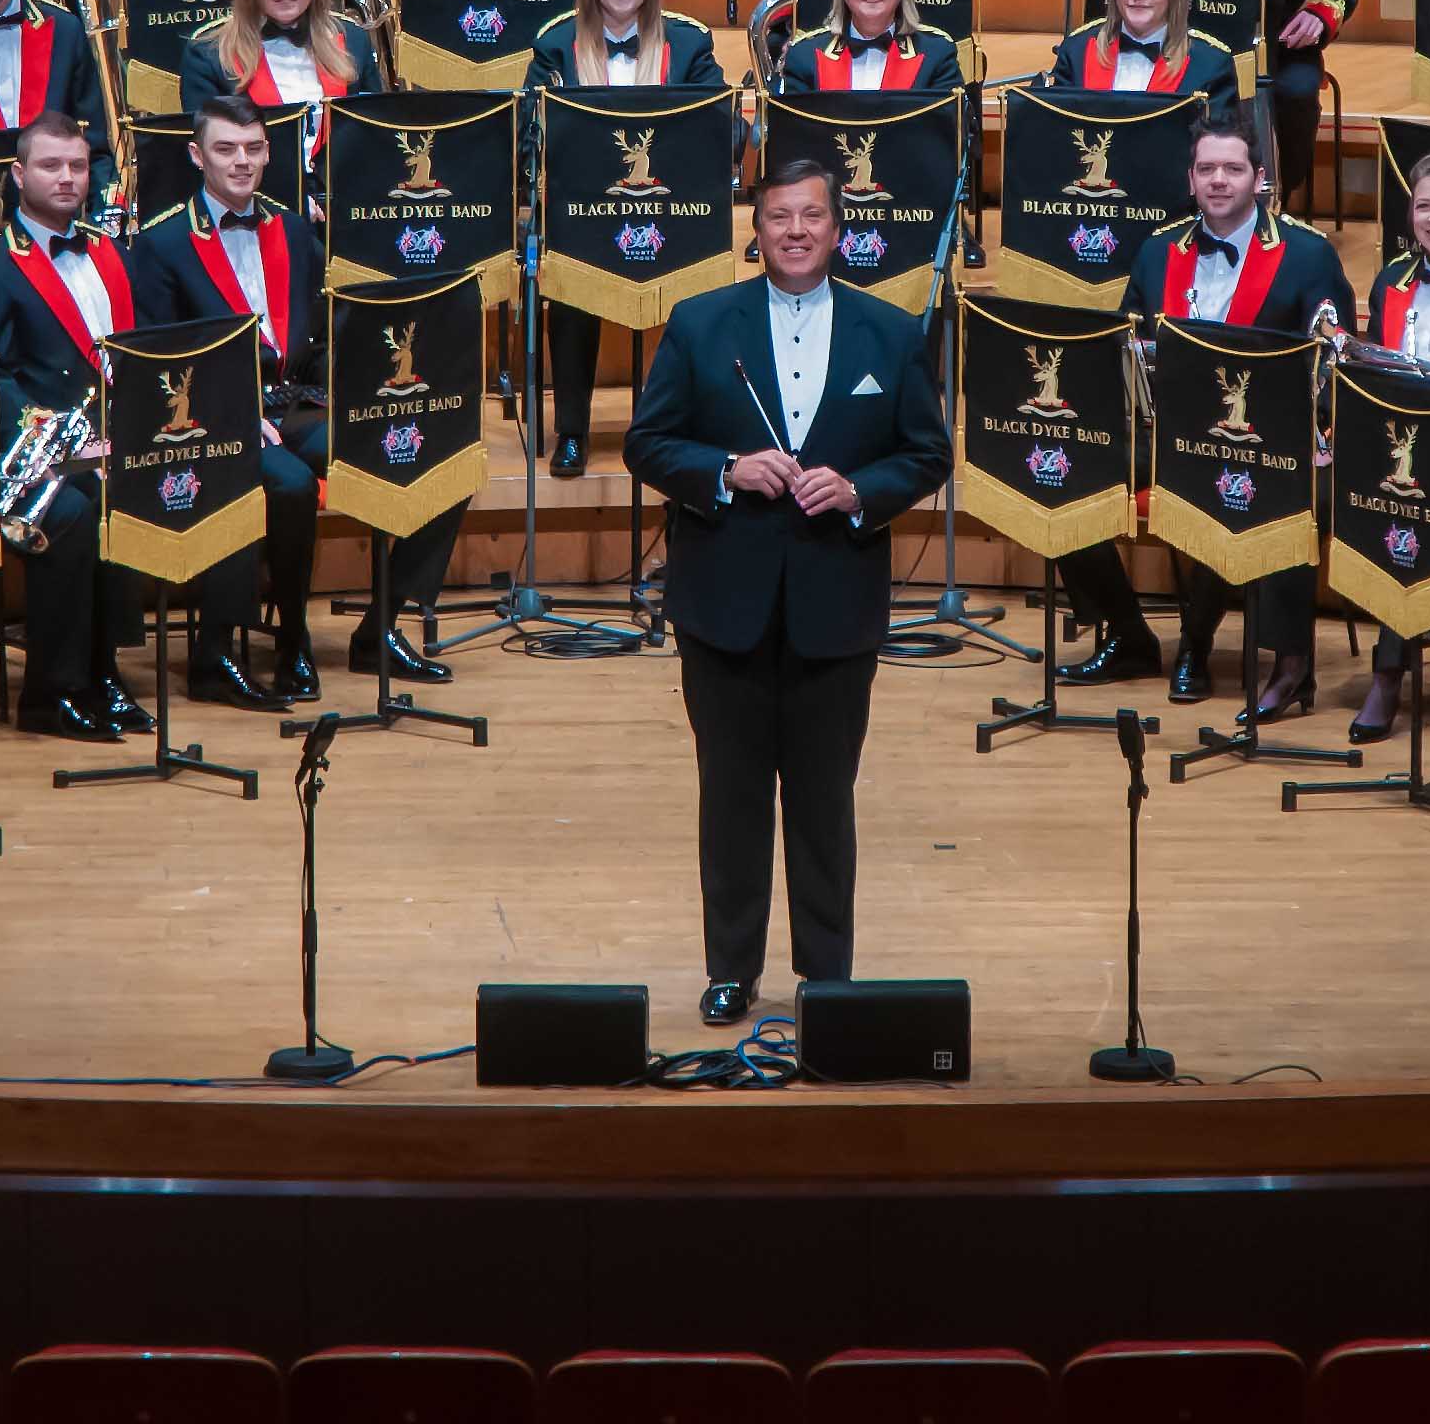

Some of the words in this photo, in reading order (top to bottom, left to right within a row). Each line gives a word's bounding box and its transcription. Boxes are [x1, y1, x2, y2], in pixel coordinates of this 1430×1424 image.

[148, 10, 192, 25] BLACK
[1199, 0, 1236, 15] BAND
[351, 206, 397, 219] BLACK
[403, 205, 444, 218] DYKE
[451, 205, 491, 217] BAND
[568, 203, 617, 216] BLACK
[621, 203, 662, 214] DYKE
[671, 203, 710, 215] BAND
[844, 208, 885, 220] DYKE
[893, 209, 933, 221] BAND
[1023, 200, 1072, 215] BLACK
[1076, 203, 1118, 217] DYKE
[1126, 207, 1166, 220] BAND
[349, 405, 383, 422] BLACK
[388, 400, 425, 415] DYKE
[429, 396, 462, 411] BAND
[984, 417, 1031, 434] BLACK
[1032, 423, 1070, 438] DYKE
[1077, 428, 1110, 445] BAND
[125, 452, 160, 469] BLACK
[165, 445, 200, 463] DYKE
[207, 441, 242, 457] BAND
[1176, 438, 1217, 457] BLACK
[1221, 445, 1255, 463] DYKE
[1262, 453, 1297, 471] BAND
[1350, 492, 1386, 512] BLACK
[1389, 501, 1420, 519] DYKE
